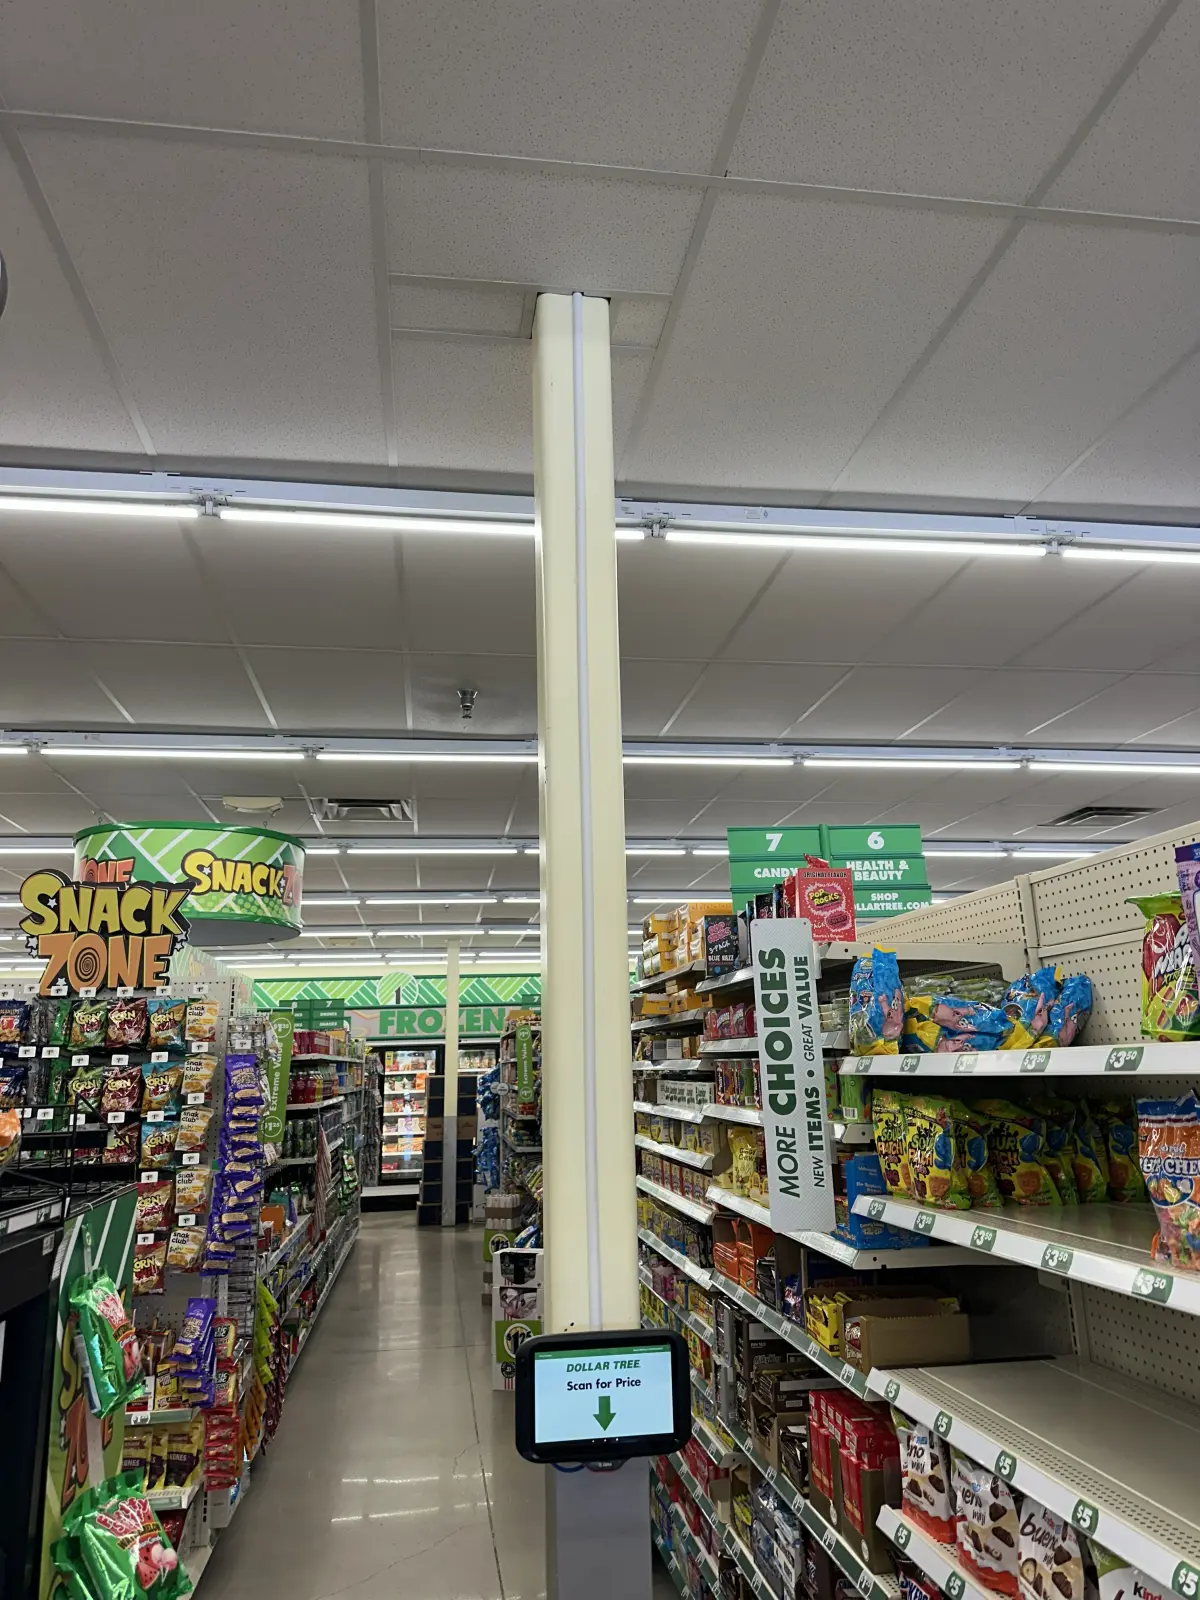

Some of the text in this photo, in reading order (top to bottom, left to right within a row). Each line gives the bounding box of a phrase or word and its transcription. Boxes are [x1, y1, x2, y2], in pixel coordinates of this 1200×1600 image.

[765, 833, 783, 851] 7
[867, 831, 885, 850] 6
[184, 851, 284, 897] SNACK
[846, 860, 909, 871] HEALTH &
[854, 871, 903, 881] BEAUTY
[19, 873, 183, 935] SNACK
[808, 889, 825, 900] POP
[813, 892, 840, 906] ROCKS
[871, 893, 899, 901] SHOP
[38, 932, 173, 997] ZONE
[758, 947, 801, 1198] MORE CHOICES
[793, 956, 825, 1188] NEW ITEMS GREAT VALUE
[270, 1071, 281, 1112] Extreme
[172, 1231, 190, 1239] snak
[566, 1359, 641, 1373] DOLLAR TREE
[566, 1376, 641, 1391] Scan for Price
[887, 1382, 898, 1398] $5
[937, 1414, 949, 1434] $5
[999, 1455, 1012, 1476] $5
[1076, 1504, 1093, 1528] $5
[897, 1526, 907, 1543] $5
[949, 1574, 962, 1595] $5
[1178, 1567, 1199, 1596] $5
